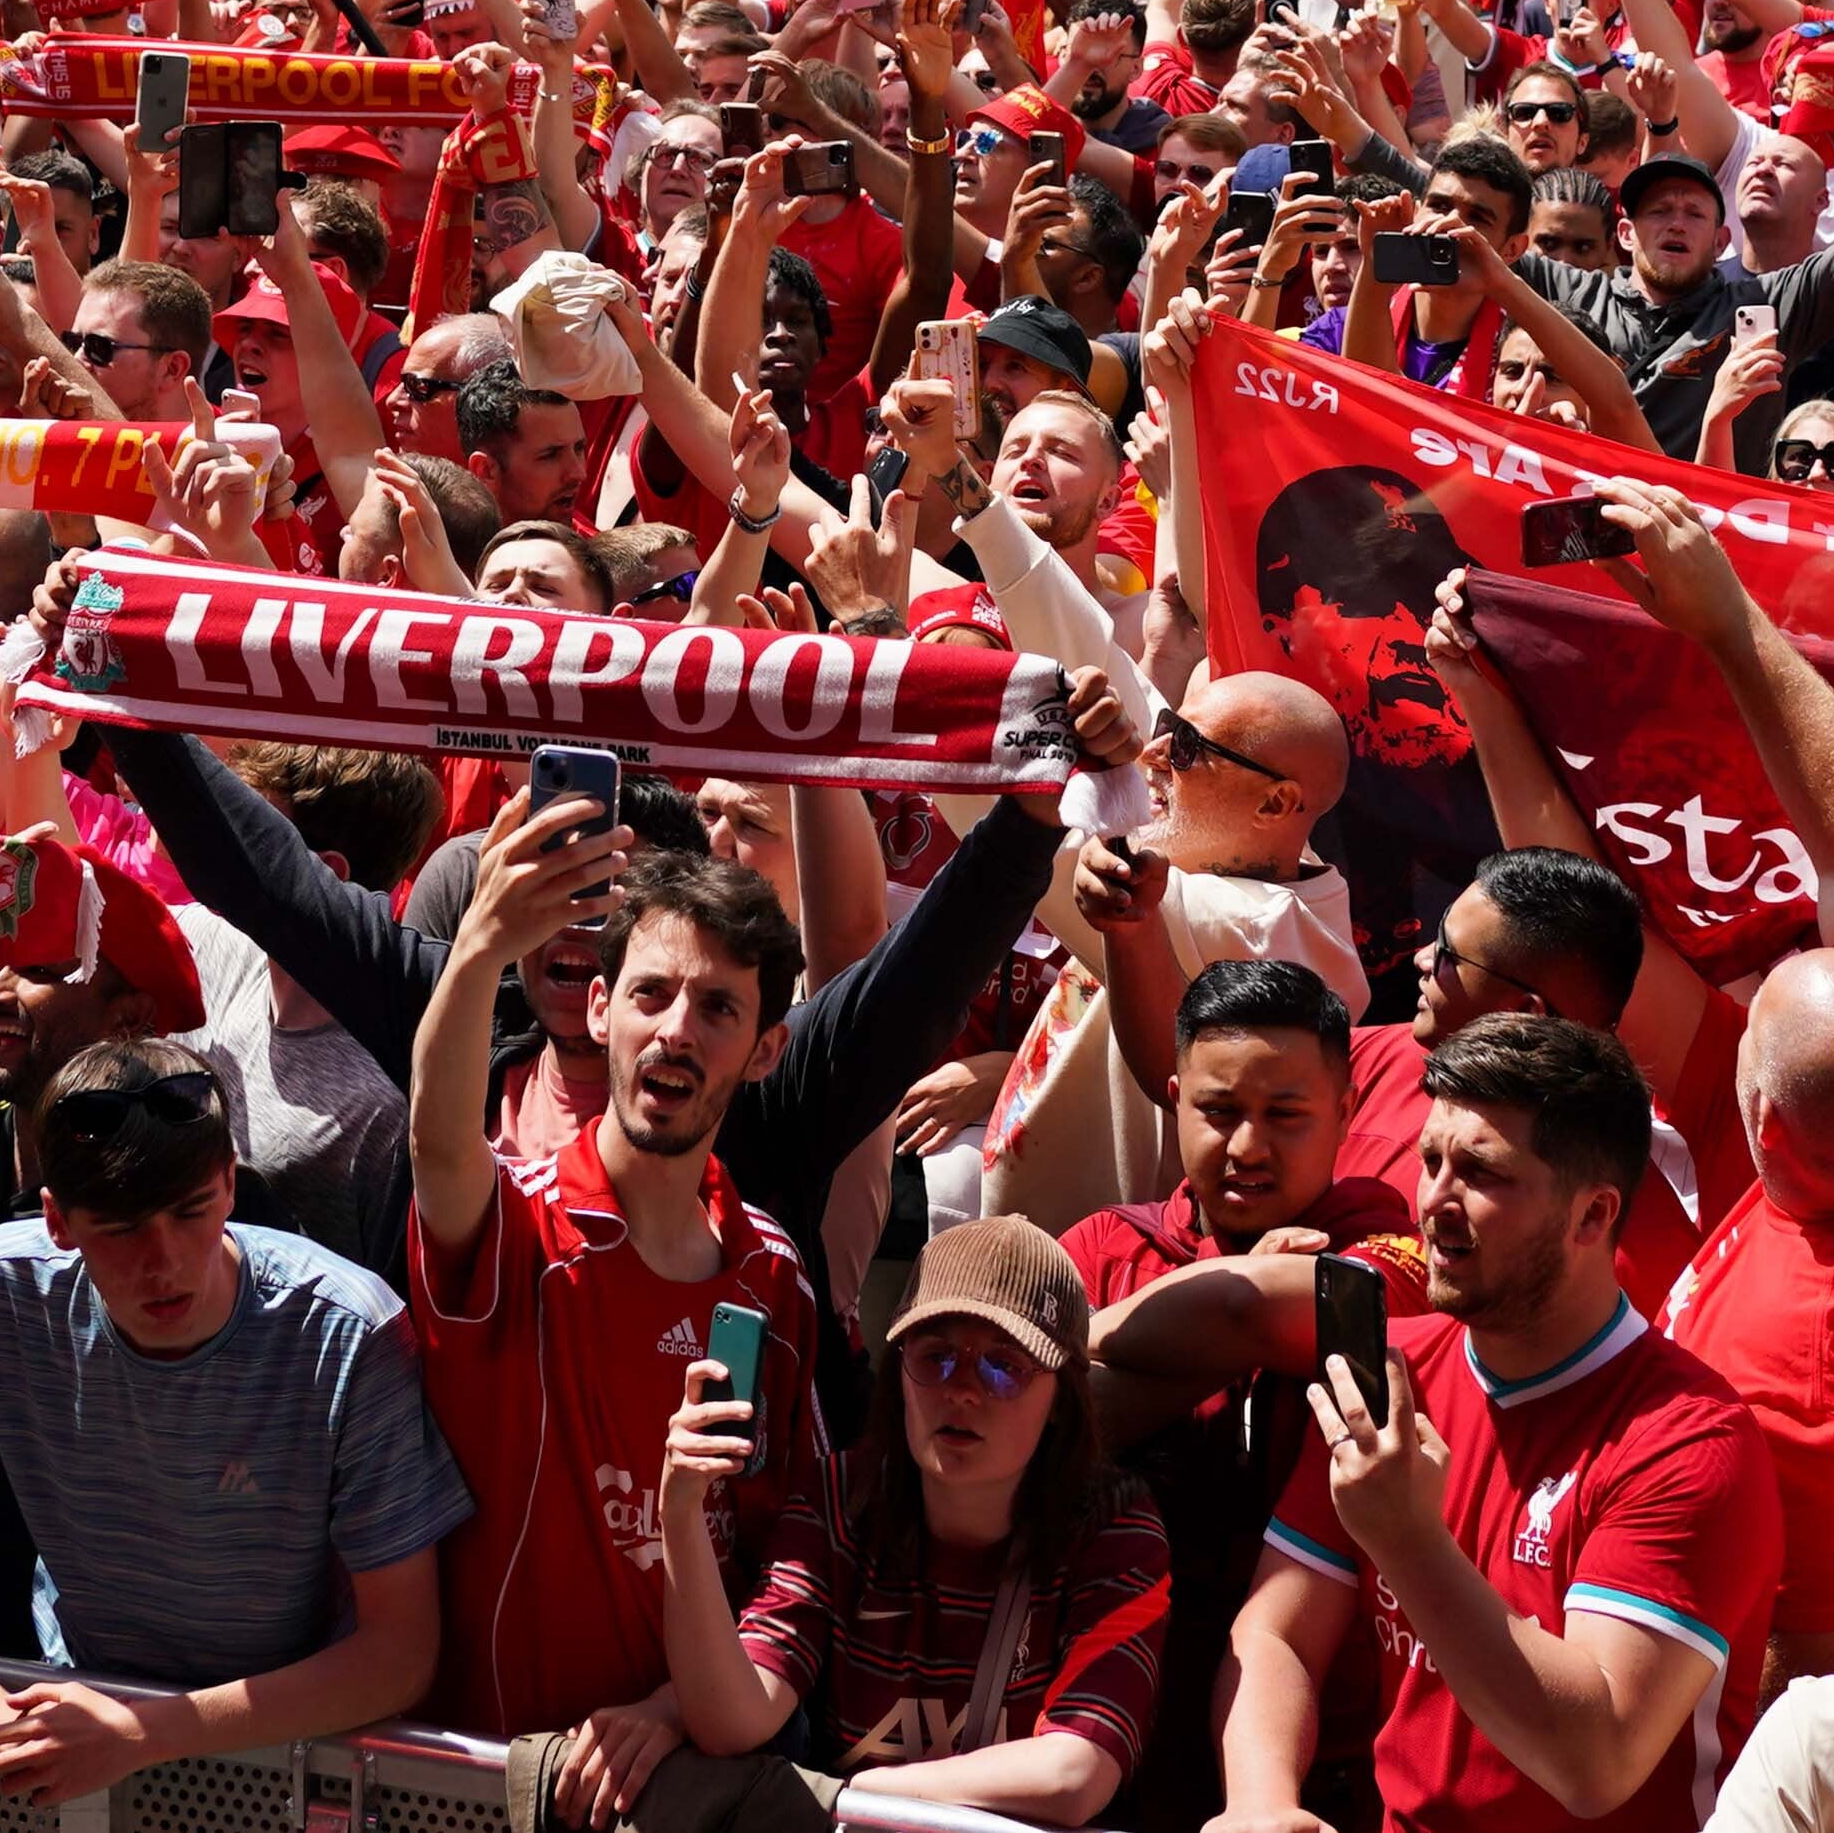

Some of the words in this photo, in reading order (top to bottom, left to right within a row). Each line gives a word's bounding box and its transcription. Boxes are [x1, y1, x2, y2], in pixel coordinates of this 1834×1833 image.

[94, 52, 391, 106] LIERPOOL
[70, 427, 101, 485] 7
[165, 591, 940, 747] LIVERPOOL
[656, 1340, 705, 1359] adidas
